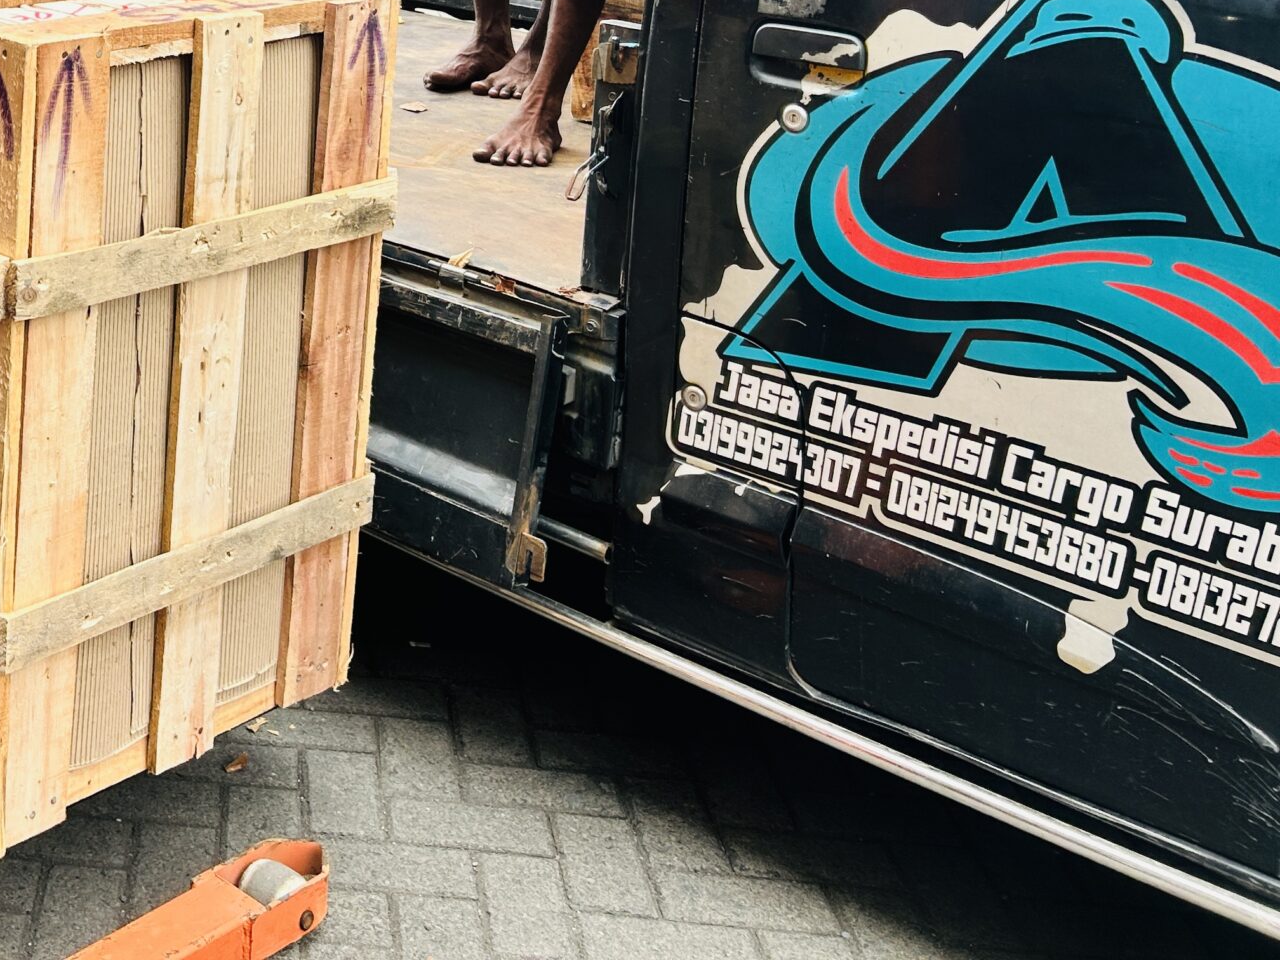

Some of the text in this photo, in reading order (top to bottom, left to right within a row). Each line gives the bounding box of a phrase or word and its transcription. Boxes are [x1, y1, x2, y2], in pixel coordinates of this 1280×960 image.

[719, 361, 801, 422] Jasa
[808, 386, 997, 481] Ekspedisi
[1000, 443, 1134, 528] Cargo
